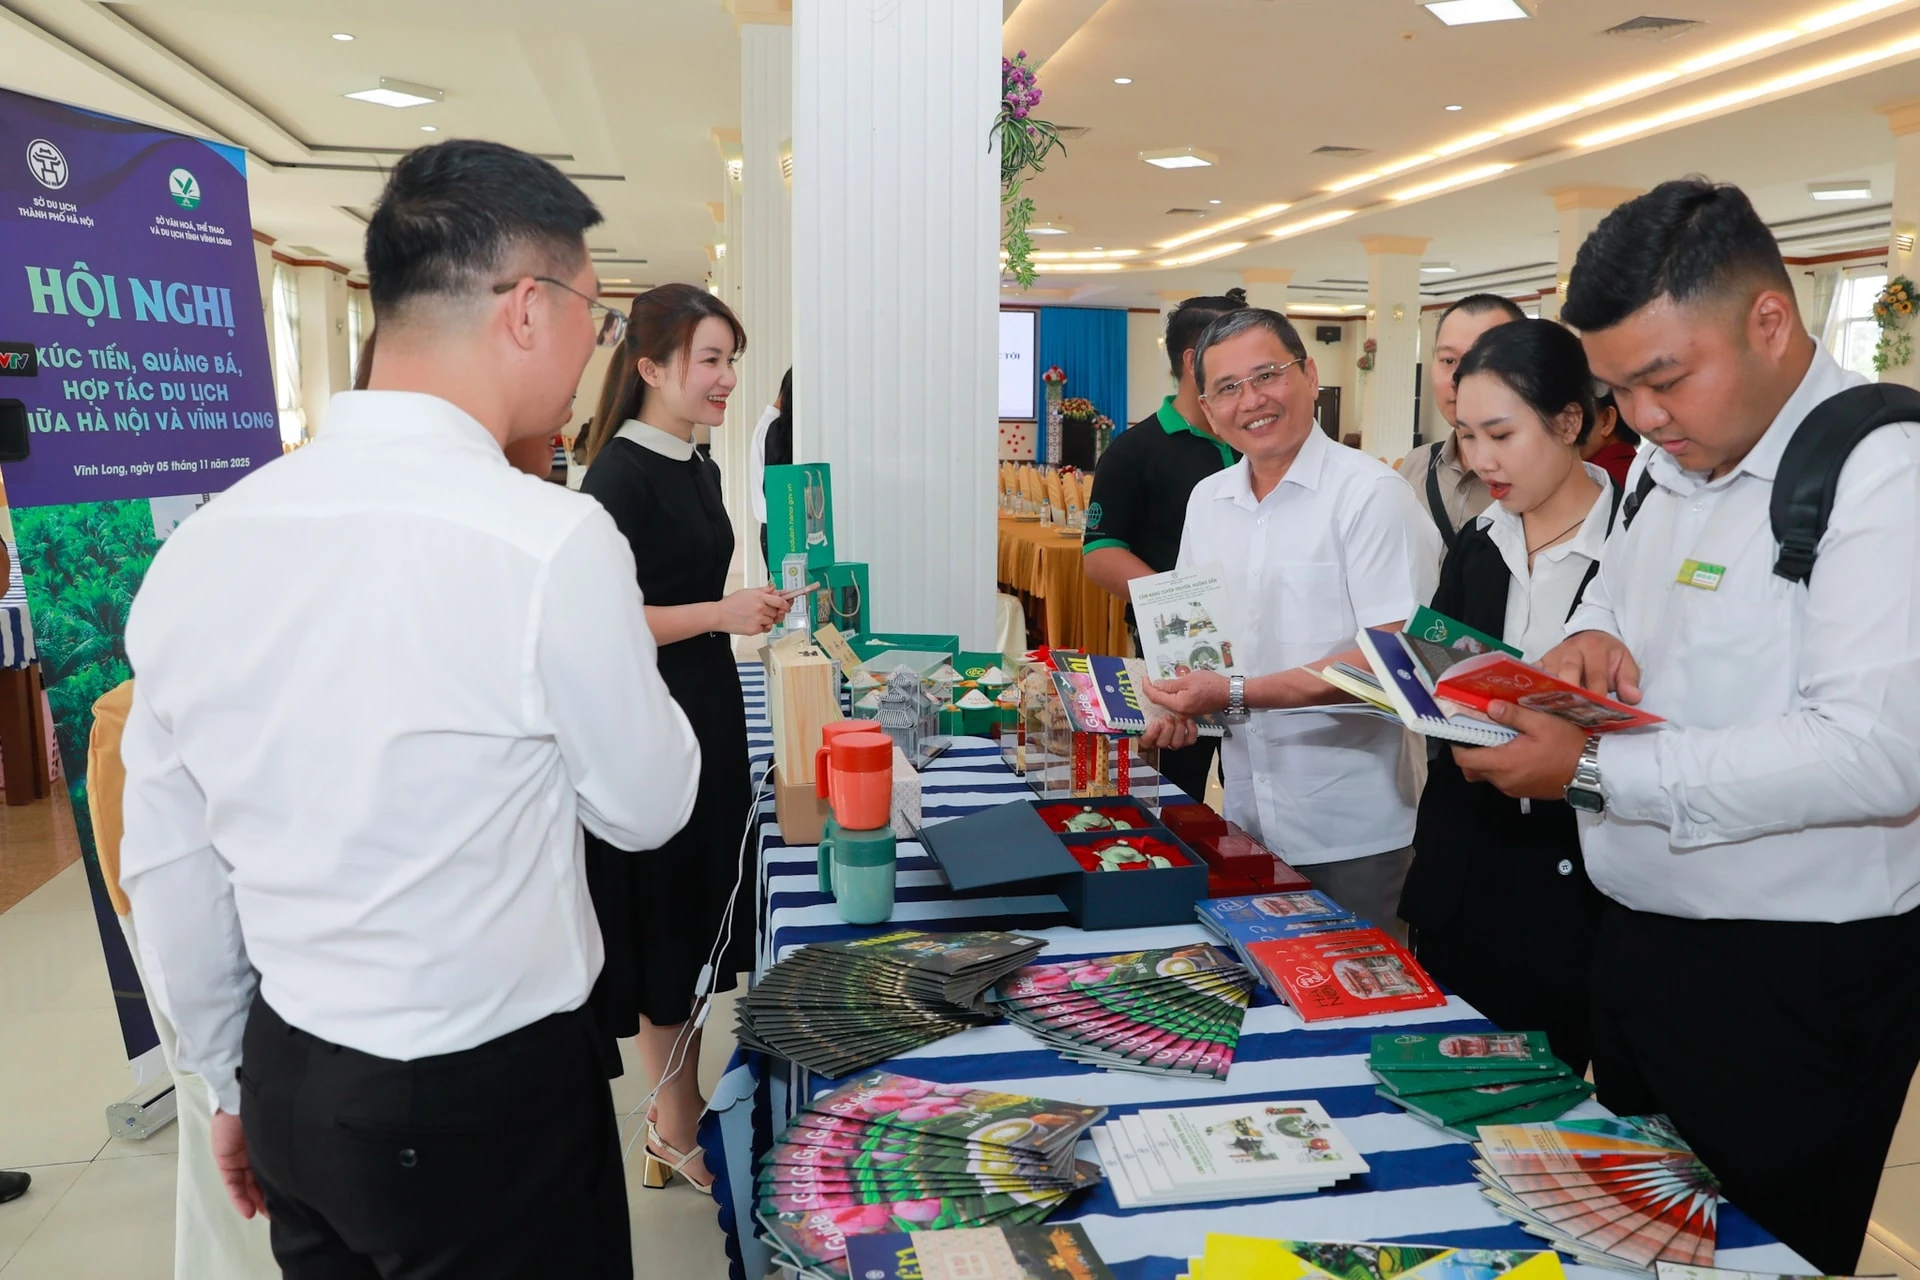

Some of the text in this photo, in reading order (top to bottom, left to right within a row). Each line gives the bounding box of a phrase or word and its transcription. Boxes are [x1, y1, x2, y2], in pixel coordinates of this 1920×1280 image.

[33, 196, 77, 213] SỞ DU LỊCH
[18, 206, 95, 228] THÀNH PHỐ HÀ NỘI
[150, 225, 160, 236] VÀ
[161, 229, 170, 238] DU
[216, 236, 232, 247] LONG
[208, 225, 224, 235] THAO
[25, 261, 235, 337] HỘI NGHỊ
[0, 352, 29, 369] VTV
[35, 342, 243, 377] XÚC TIẾN, QUẢNG BÁ,
[63, 377, 229, 406] HỢP TÁC DU LỊCH
[26, 407, 274, 436] IỮA HÀ NỘI VÀ VĨNH LONG
[73, 457, 250, 477] Vĩnh Long, ngày 05 tháng 11 năm 2025
[1078, 693, 1099, 729] Guide
[829, 1089, 883, 1113] Guide
[808, 1214, 846, 1251] Guide
